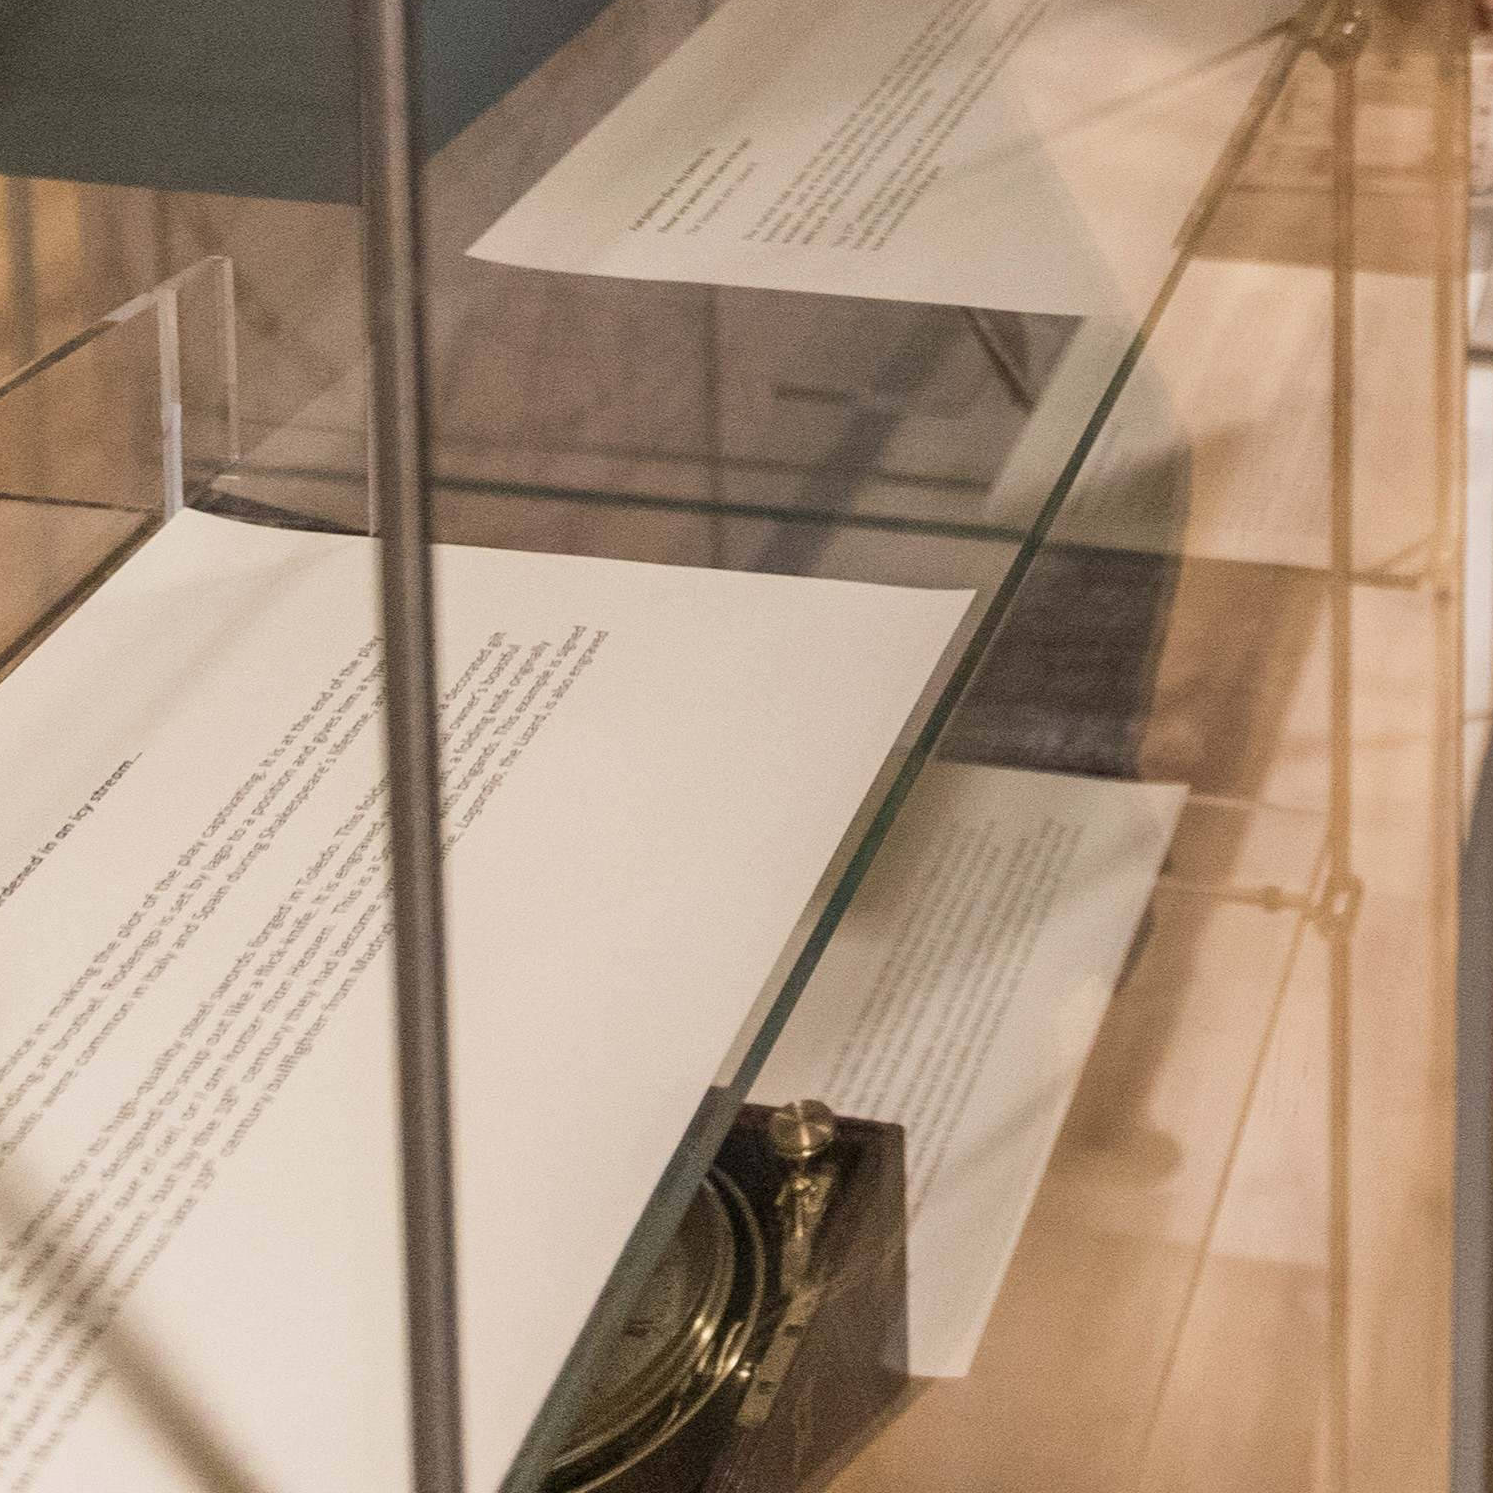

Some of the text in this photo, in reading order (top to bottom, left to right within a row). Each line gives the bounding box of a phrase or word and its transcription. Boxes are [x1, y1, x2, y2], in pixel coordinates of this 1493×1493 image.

[41, 967, 103, 1018] making
[110, 911, 151, 938] plot
[171, 840, 212, 866] play
[73, 1002, 135, 1065] common
[138, 952, 180, 982] Italy
[189, 886, 235, 920] Spain
[221, 842, 272, 882] during
[256, 758, 341, 839] Shakespeare's
[325, 709, 381, 755] lifetime,
[98, 1039, 192, 1133] high-quality
[174, 1001, 218, 1037] steel
[204, 951, 258, 999] swords
[245, 906, 297, 947] forged
[293, 842, 343, 887] Toledo.
[440, 649, 494, 699] decorated
[100, 929, 167, 989] Roderigo
[200, 844, 239, 870] Iago
[246, 768, 303, 815] position
[306, 716, 347, 742] gives
[174, 1050, 215, 1085] snap
[199, 1020, 233, 1046] out
[253, 908, 320, 977] flick-knife.
[443, 687, 490, 729] owner's
[478, 644, 523, 684] boastful
[219, 1015, 269, 1062] hotter
[256, 980, 295, 1012] than
[331, 889, 364, 914] This
[452, 716, 498, 753] folding
[502, 641, 554, 686] originally
[236, 1025, 297, 1082] century
[281, 990, 323, 1022] they
[307, 960, 341, 986] had
[329, 904, 382, 956] become
[452, 741, 506, 790] brigands.
[509, 670, 558, 712] example
[550, 625, 591, 656] signed
[261, 1014, 335, 1092] bullfighter
[319, 977, 358, 1011] from
[511, 712, 555, 746] Lizard,
[562, 630, 614, 676] engraved
